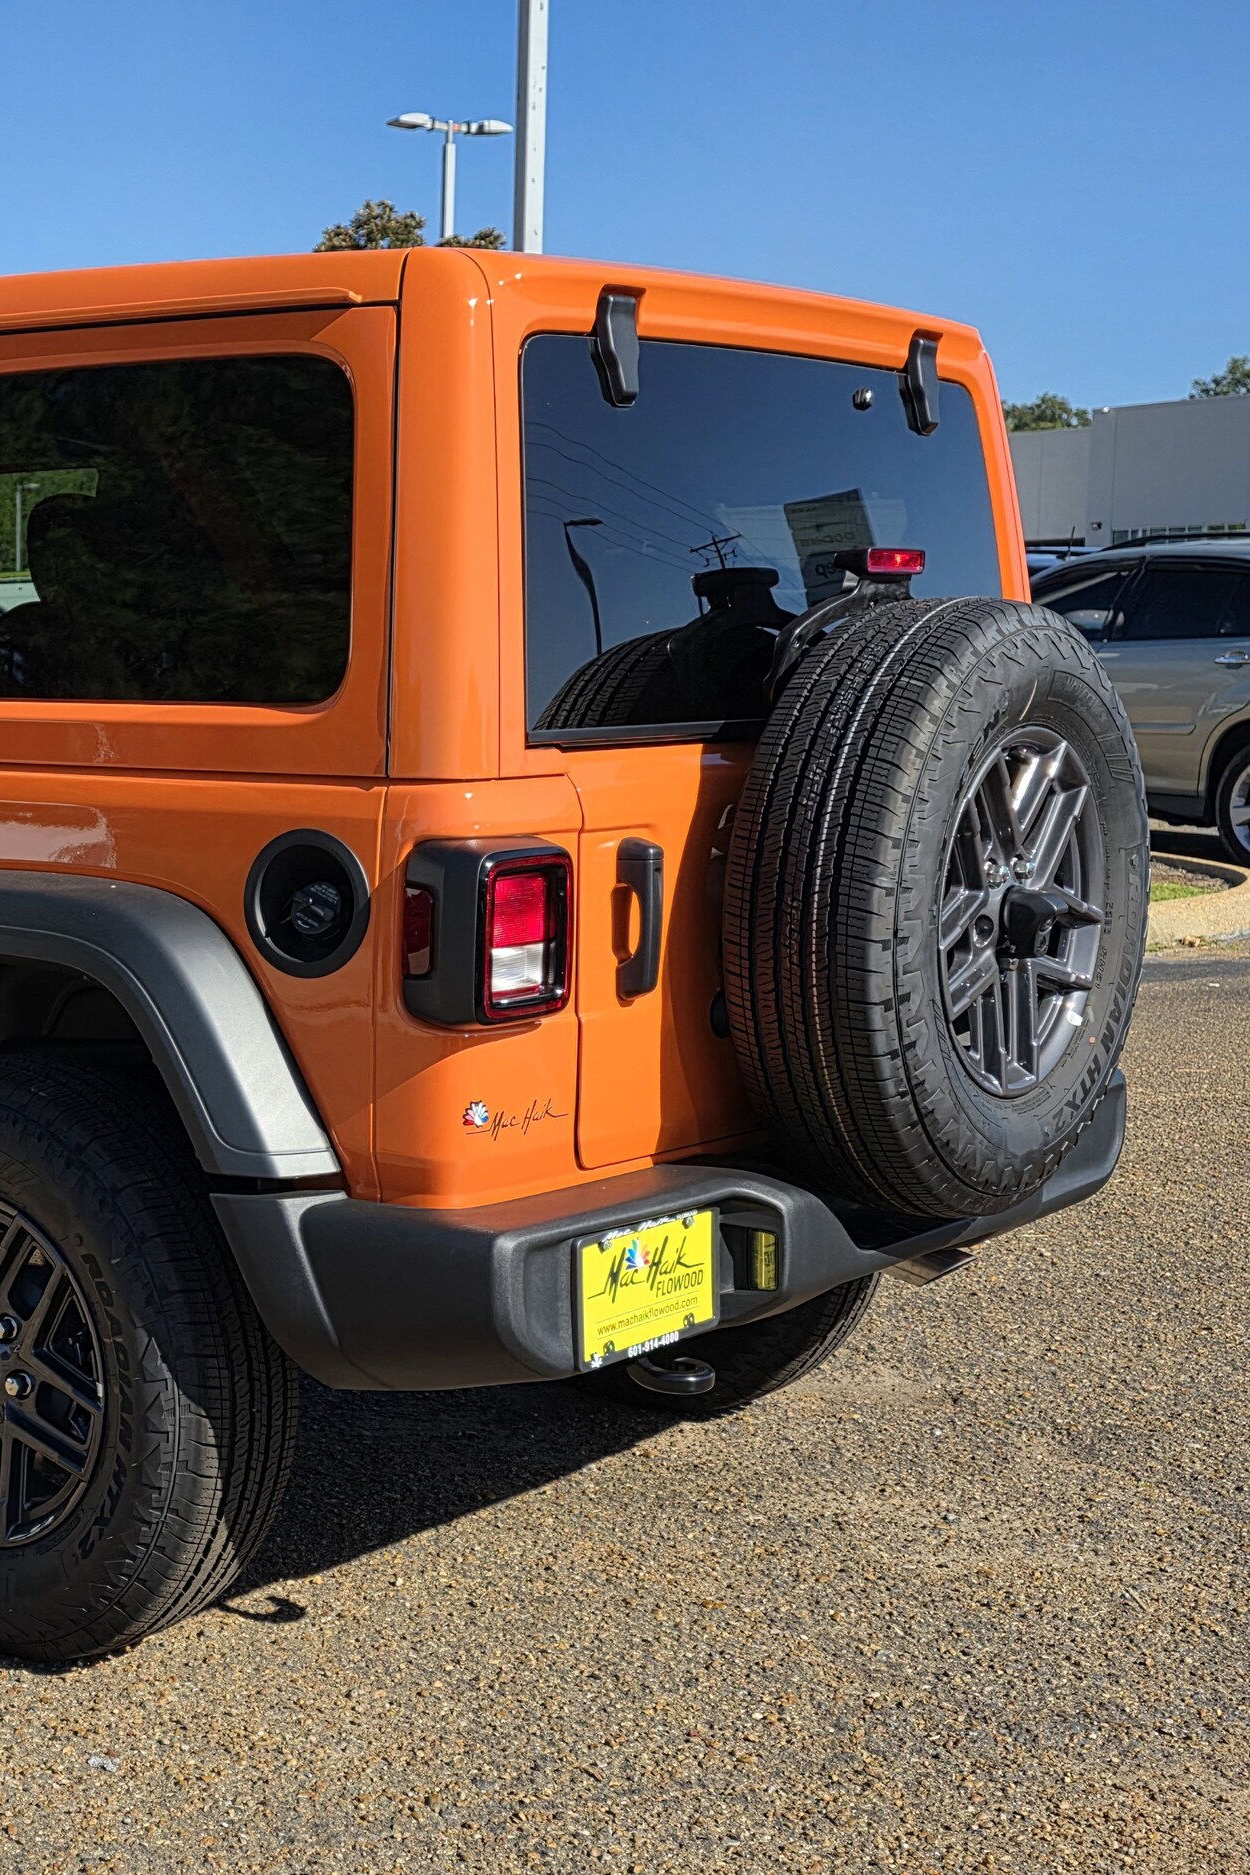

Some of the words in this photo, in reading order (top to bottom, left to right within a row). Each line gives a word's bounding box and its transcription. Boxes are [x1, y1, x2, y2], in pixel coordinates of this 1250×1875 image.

[466, 1111, 520, 1141] Mac
[521, 1098, 569, 1135] Haik
[588, 1246, 645, 1304] Mac
[646, 1235, 706, 1291] Haik
[656, 1269, 703, 1298] FLOWOOD
[597, 1296, 698, 1336] www.machaikflowood.com
[628, 1331, 679, 1358] 601-914-4000
